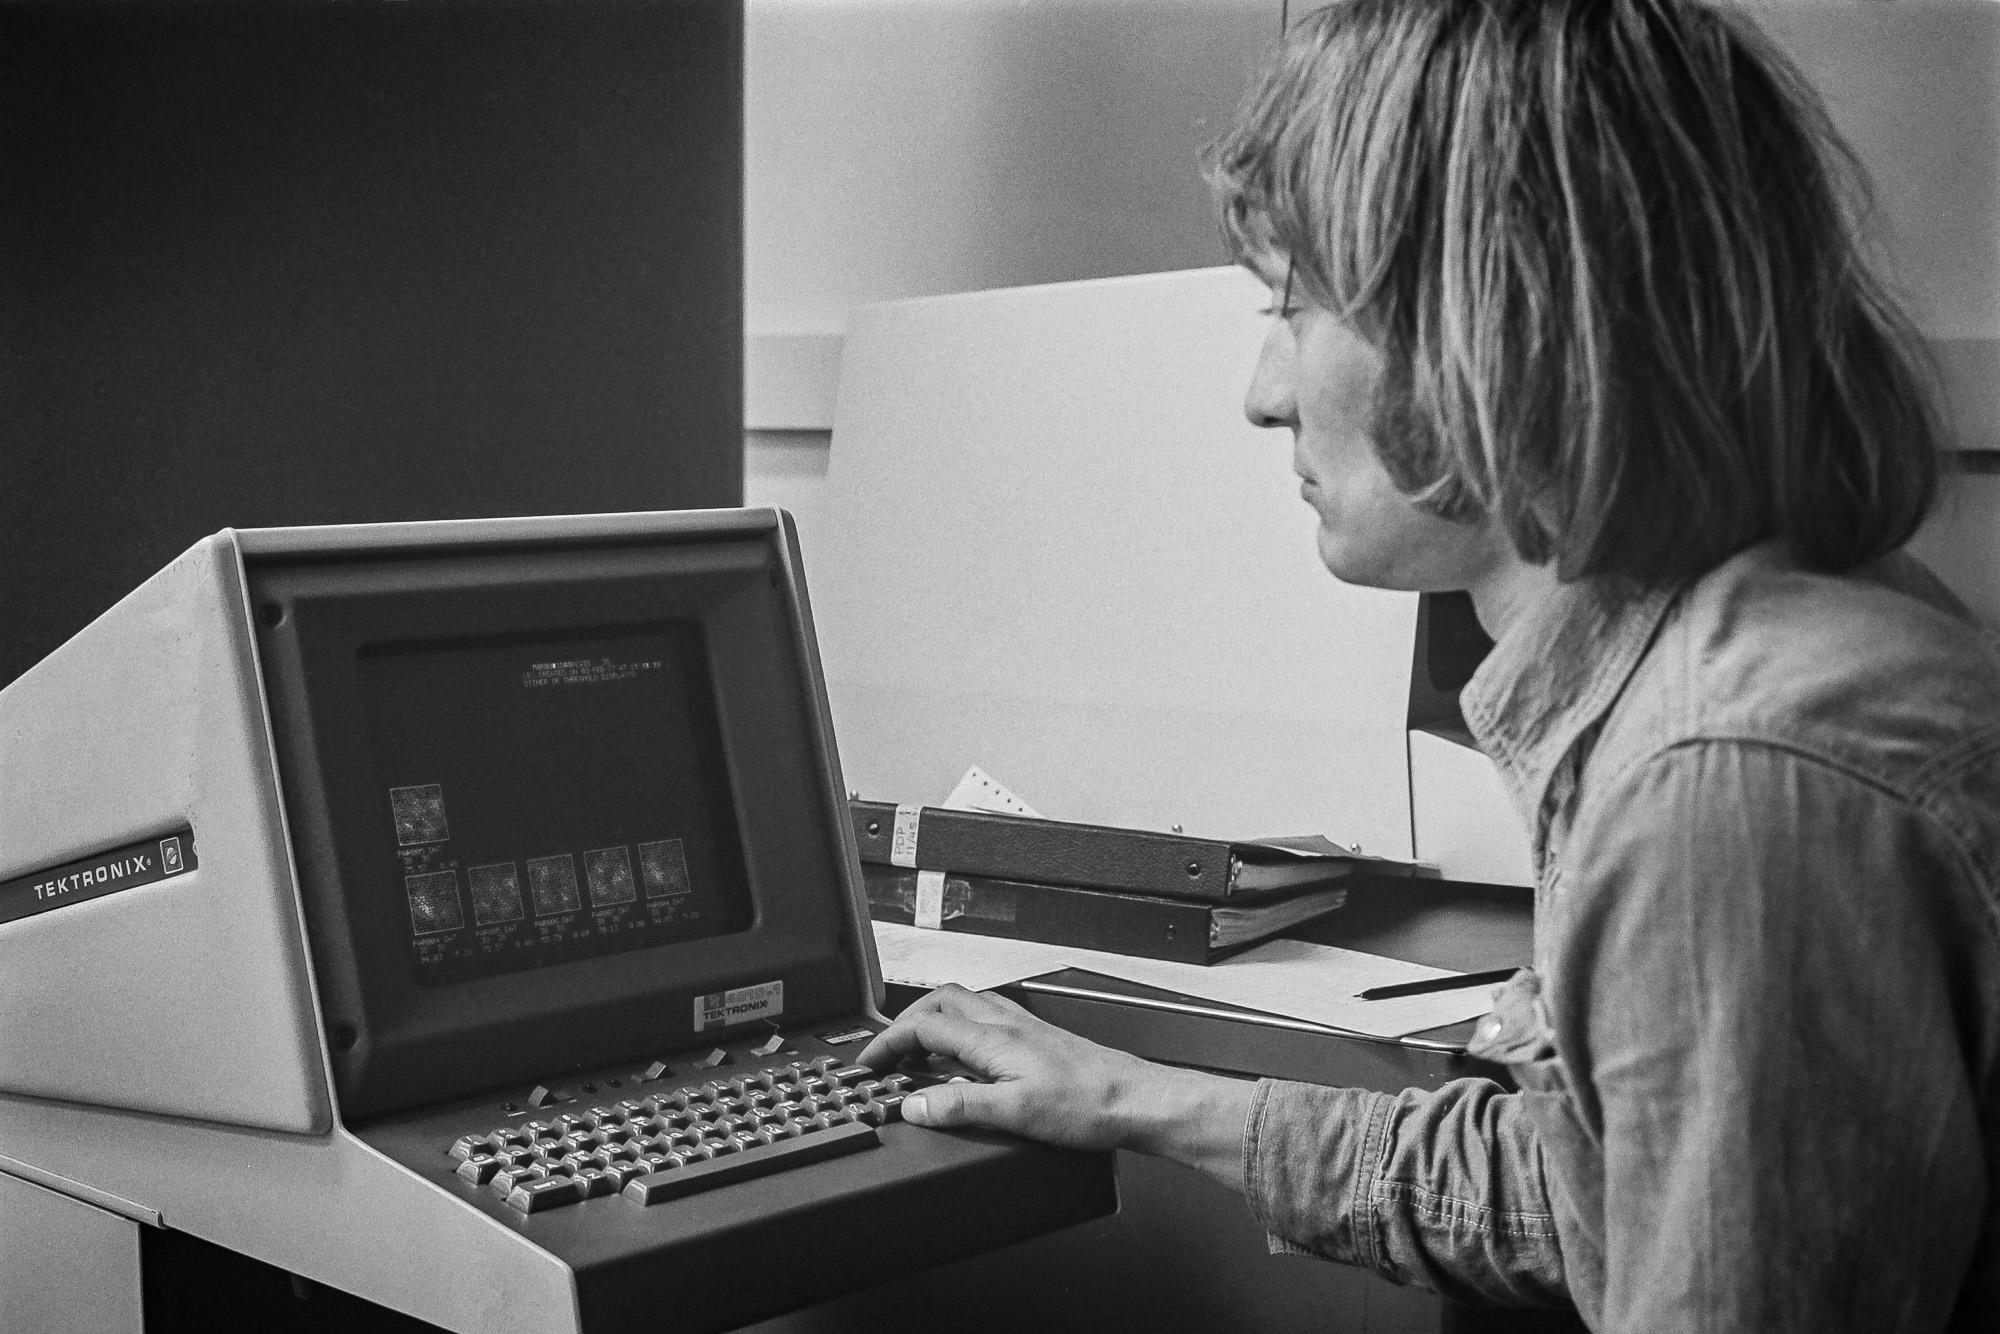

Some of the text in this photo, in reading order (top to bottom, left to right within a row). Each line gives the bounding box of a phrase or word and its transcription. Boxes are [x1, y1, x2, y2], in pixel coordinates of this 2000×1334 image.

[523, 678, 548, 688] DITHER
[562, 673, 599, 684] THRESHOLD
[537, 668, 567, 679] CREATED
[33, 855, 148, 900] TEKTRONIX
[725, 983, 781, 1005] 4010-1
[703, 999, 767, 1021] TEKTRONIX
